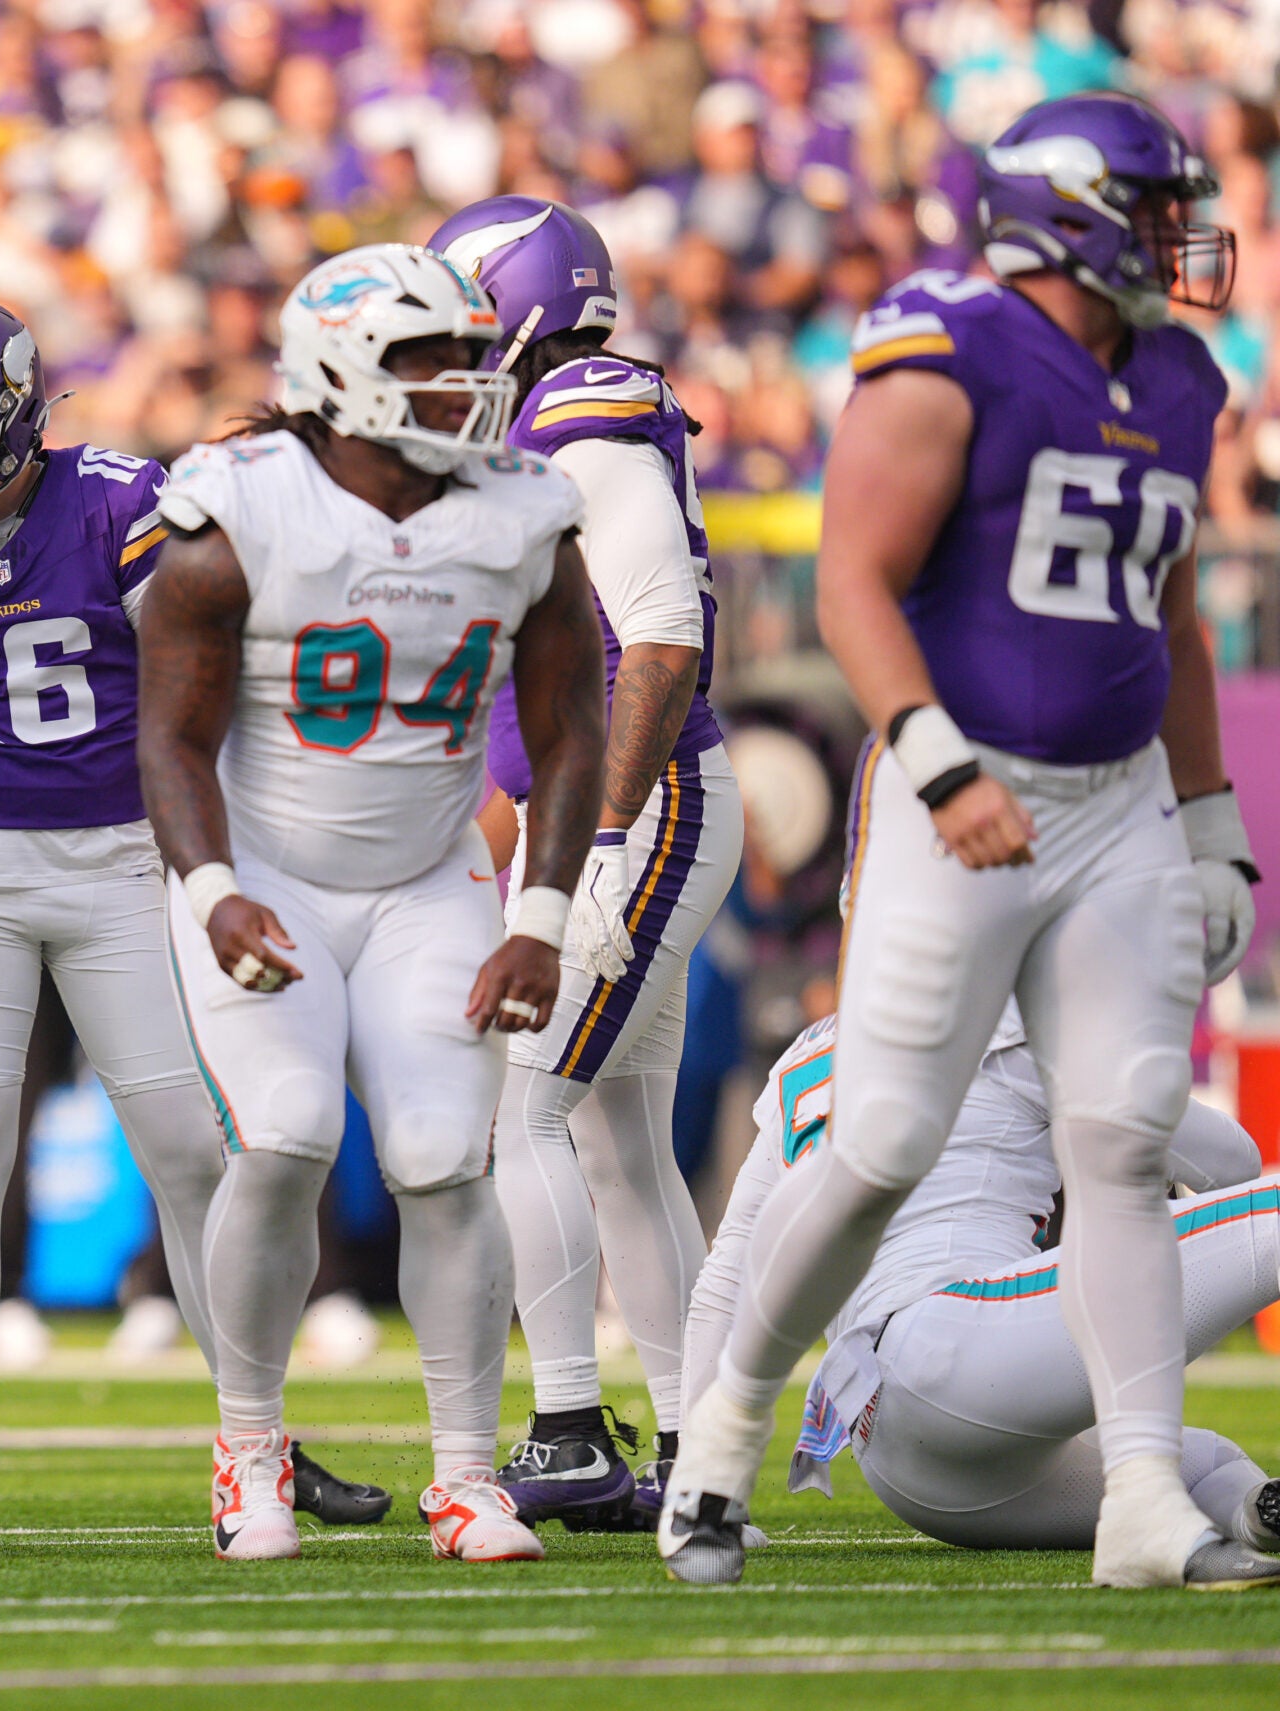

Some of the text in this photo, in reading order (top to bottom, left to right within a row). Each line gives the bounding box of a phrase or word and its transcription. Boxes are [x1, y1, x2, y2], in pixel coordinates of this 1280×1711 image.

[77, 445, 149, 485] 16
[1007, 448, 1199, 631] 60
[284, 618, 502, 755] 94
